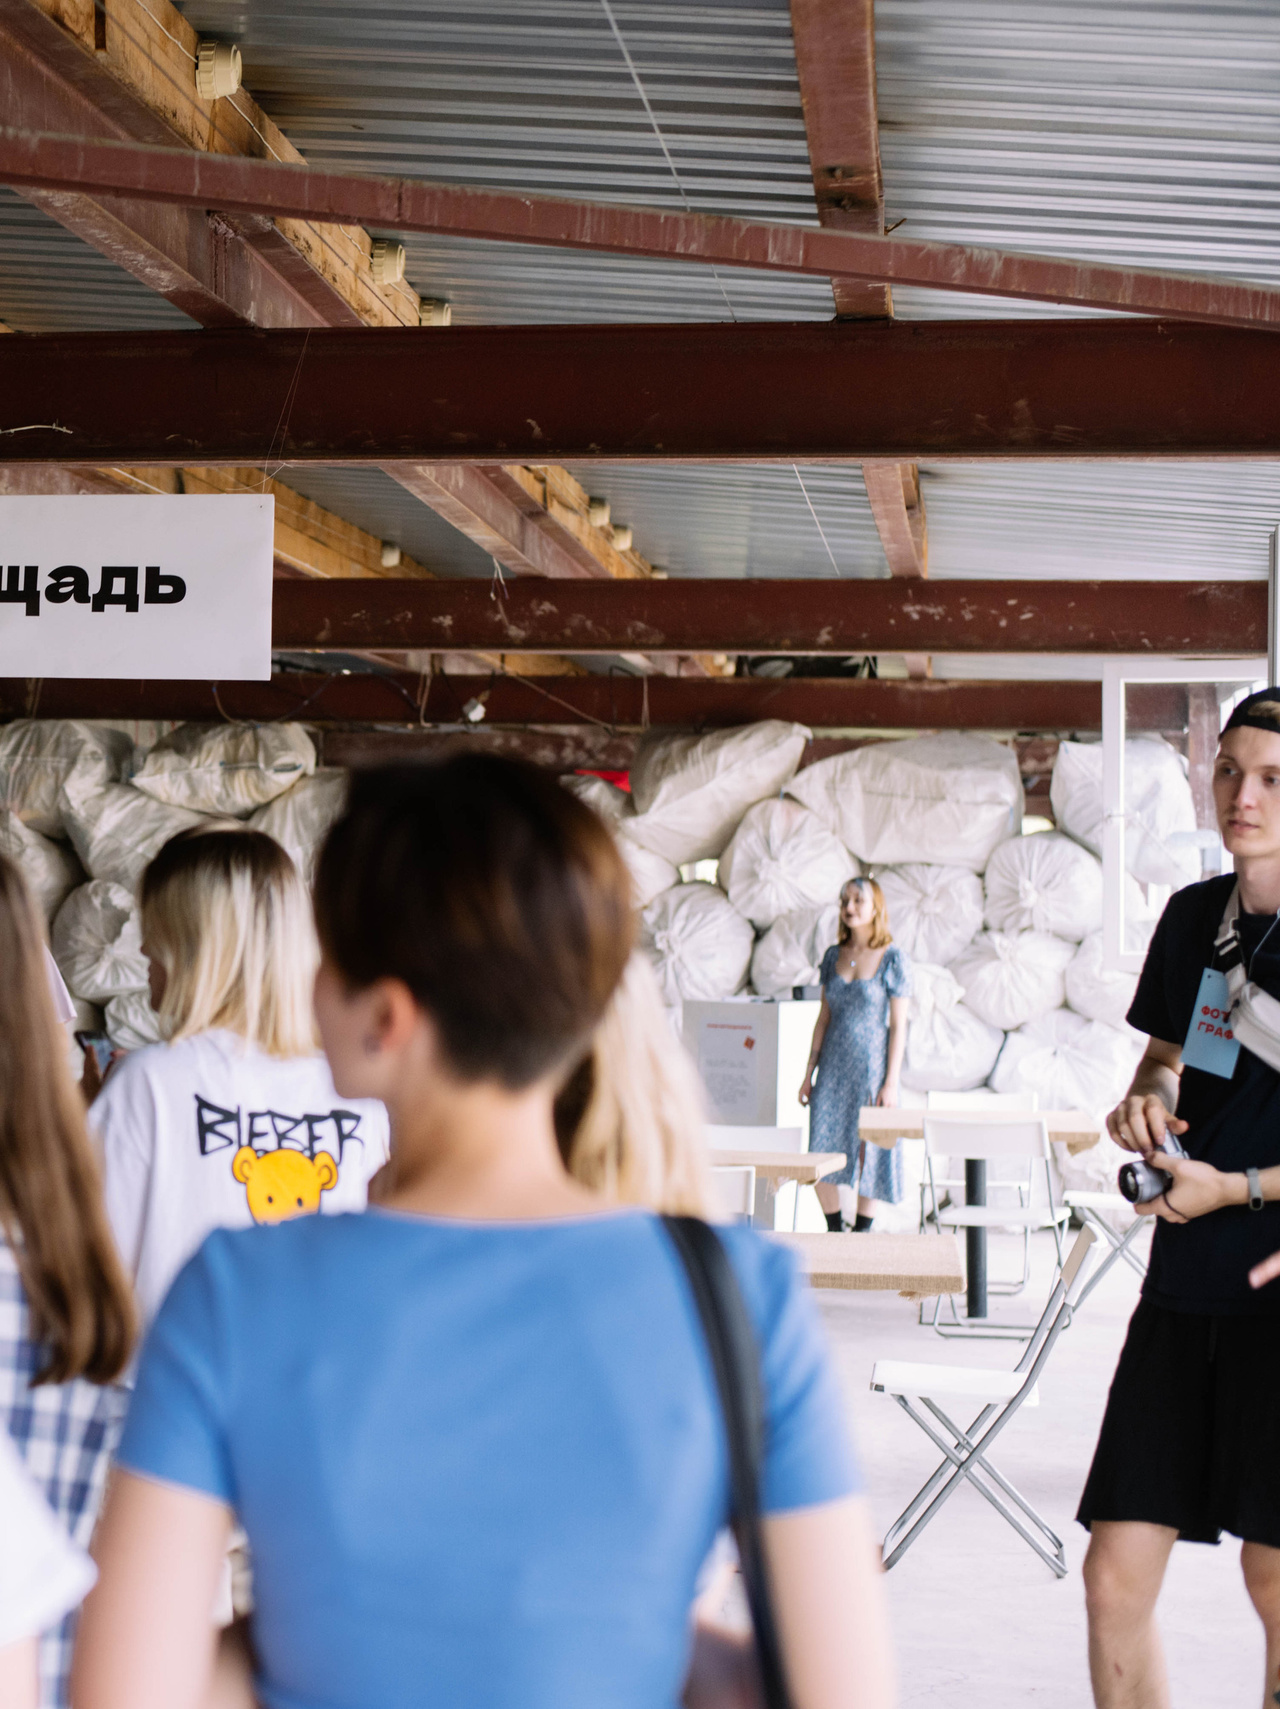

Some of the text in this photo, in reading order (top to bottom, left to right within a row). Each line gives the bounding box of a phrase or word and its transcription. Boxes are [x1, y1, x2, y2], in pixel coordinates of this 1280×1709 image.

[1201, 1005, 1232, 1024] ФОТ
[1197, 1021, 1234, 1041] ГРАФ
[194, 1093, 365, 1166] BIEBER
